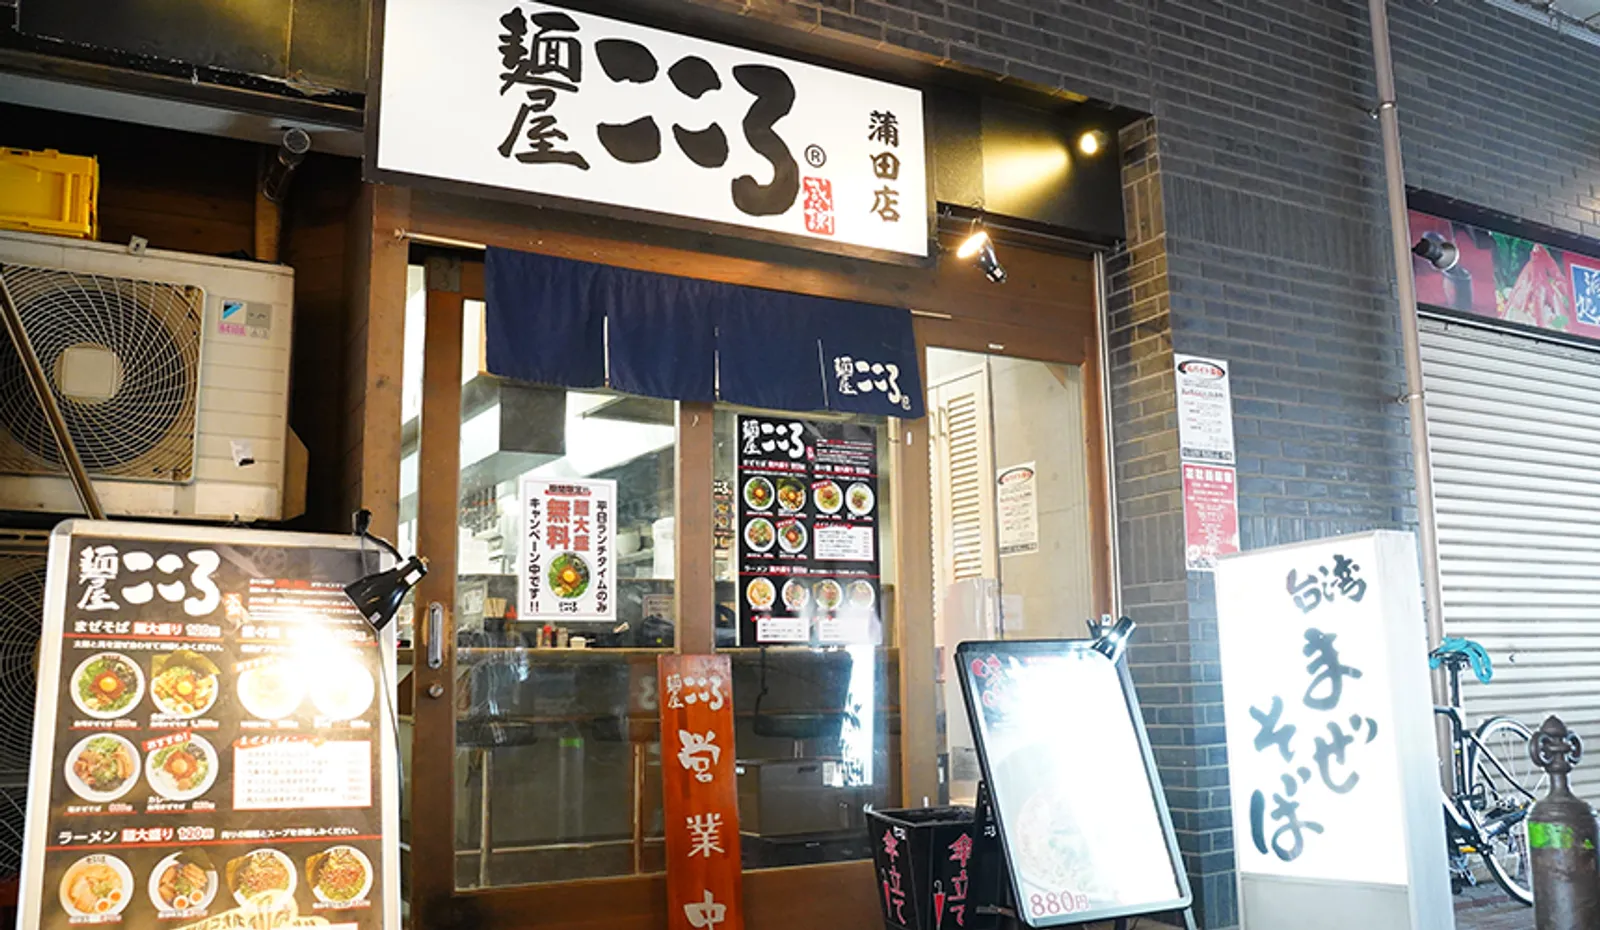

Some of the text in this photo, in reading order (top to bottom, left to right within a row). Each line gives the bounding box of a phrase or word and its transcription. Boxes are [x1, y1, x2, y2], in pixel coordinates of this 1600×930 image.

[595, 38, 800, 217] こころ
[868, 109, 900, 222] 蒲田店
[854, 360, 902, 403] こころ
[546, 498, 570, 550] 無料
[596, 500, 608, 613] 平日ランチタイムのみ
[121, 549, 221, 617] こころ
[1286, 553, 1368, 614] 台湾
[684, 675, 724, 711] こころ
[59, 830, 117, 845] ラーメン
[676, 729, 728, 930] 営業中
[948, 833, 973, 926] 傘立て
